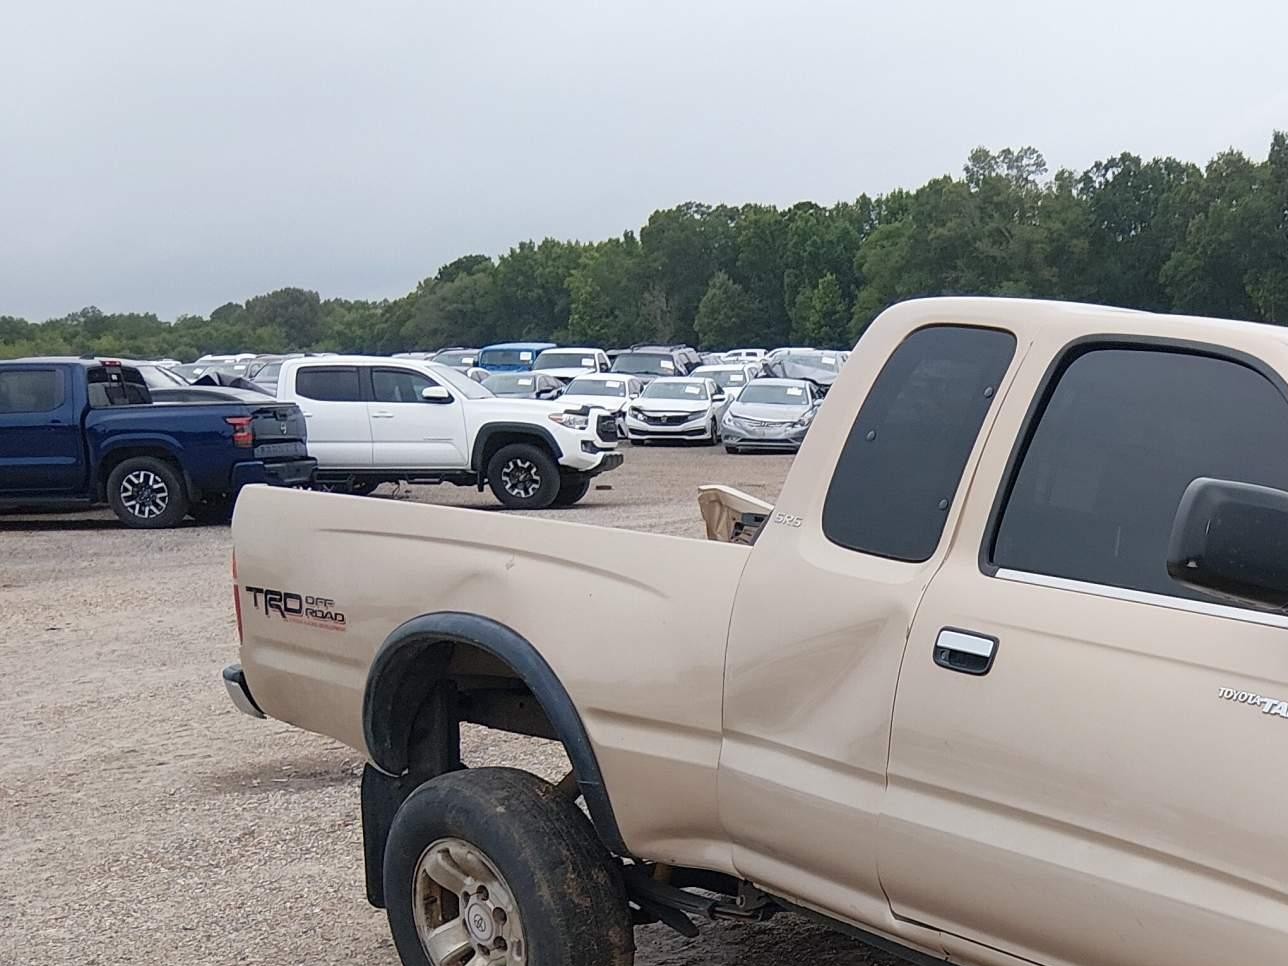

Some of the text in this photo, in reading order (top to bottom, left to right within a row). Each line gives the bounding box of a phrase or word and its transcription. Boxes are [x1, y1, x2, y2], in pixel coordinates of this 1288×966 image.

[245, 585, 303, 619] TRD
[304, 595, 335, 607] OFF
[304, 607, 346, 623] ROAD
[1218, 687, 1261, 706] TOYOTA
